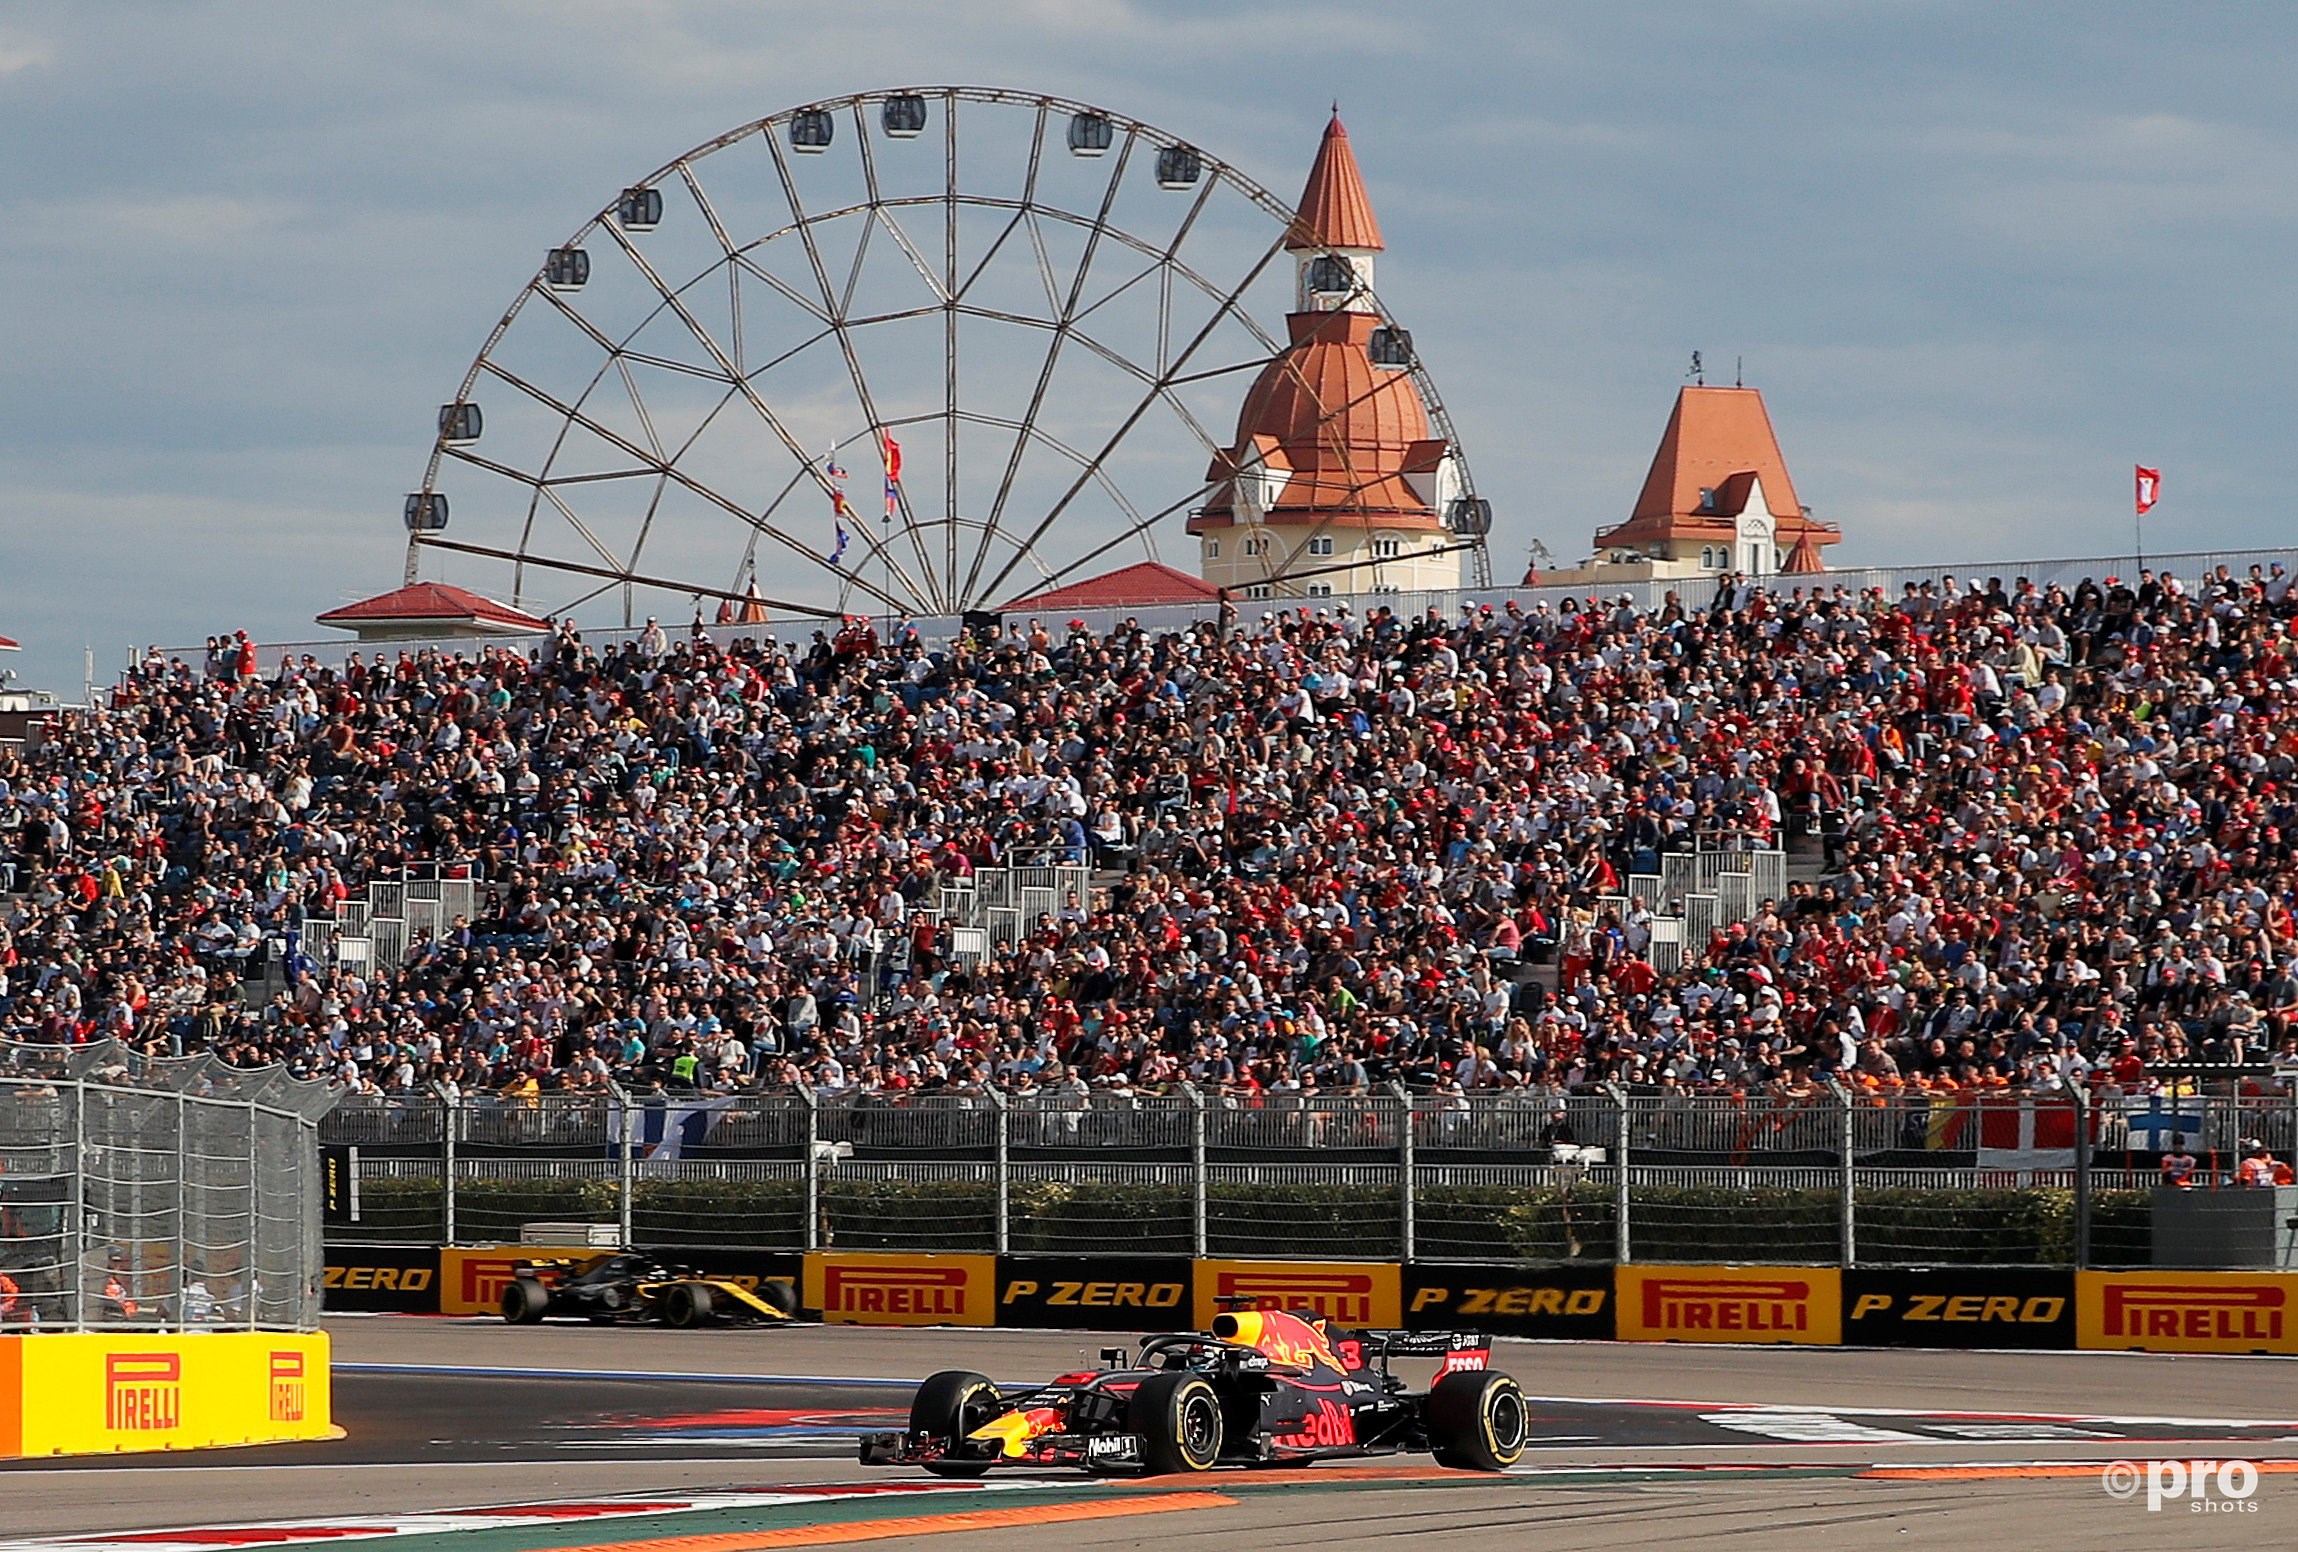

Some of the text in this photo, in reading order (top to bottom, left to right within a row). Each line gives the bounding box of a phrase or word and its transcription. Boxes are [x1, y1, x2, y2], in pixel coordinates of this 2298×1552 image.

[323, 1266, 433, 1291] ZERO
[825, 1266, 968, 1315] PIRELLI
[1002, 1281, 1184, 1308] P ZERO
[1218, 1273, 1372, 1322] PRELLI
[1410, 1287, 1606, 1316] P ZERO
[1642, 1280, 1810, 1331] PIRELLI
[1850, 1294, 2066, 1323] P ZERO
[2104, 1284, 2286, 1339] PIRELLI
[1337, 1340, 1363, 1371] 3
[106, 1353, 181, 1430] PIRELLI
[269, 1351, 305, 1421] PIRELLI
[1088, 1436, 1121, 1457] Mobil
